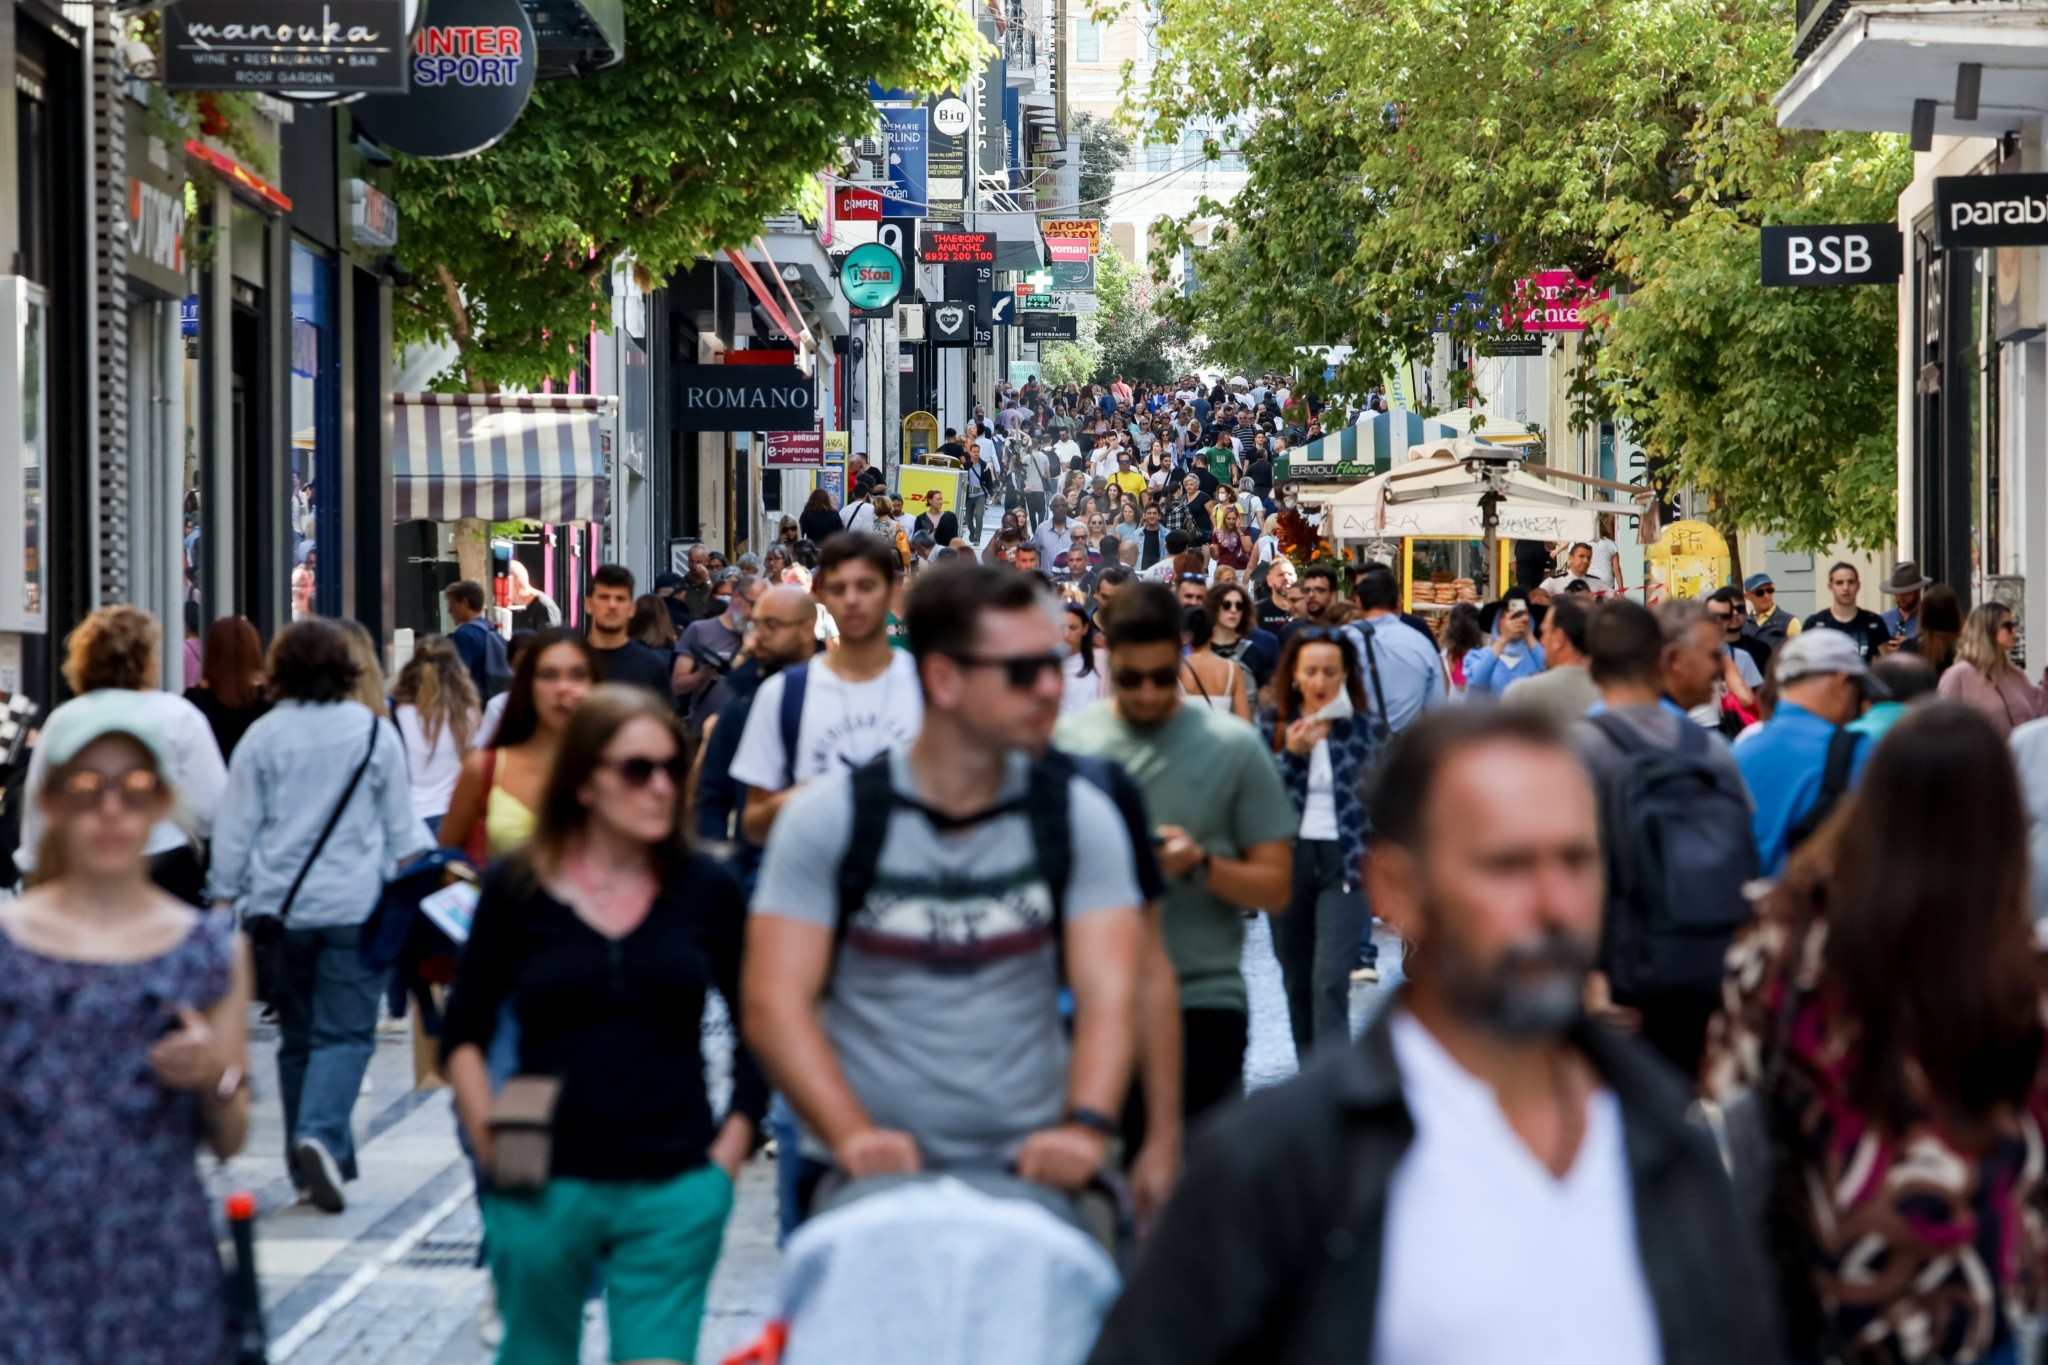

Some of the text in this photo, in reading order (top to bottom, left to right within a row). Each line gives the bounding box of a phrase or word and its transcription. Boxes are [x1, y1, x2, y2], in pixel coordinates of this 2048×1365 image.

[188, 4, 380, 50] manouka
[416, 26, 521, 56] INTER
[192, 54, 378, 67] WINE RESTAURANT BAR
[235, 71, 335, 83] ROOF GARDEN
[414, 55, 522, 86] SPORT
[843, 199, 879, 212] CAMPER
[1048, 221, 1093, 231] ΑΓΟΡΑ
[933, 234, 985, 243] ΤΗΛΕΦΩΝΟ
[937, 243, 982, 252] ΑΝΑΓΚΗΣ
[924, 252, 993, 261] 6932 200 100
[1788, 235, 1873, 275] BSB
[687, 387, 809, 408] ROMANO
[768, 446, 819, 456] e-paramana
[1290, 460, 1374, 475] ERMOU Flower
